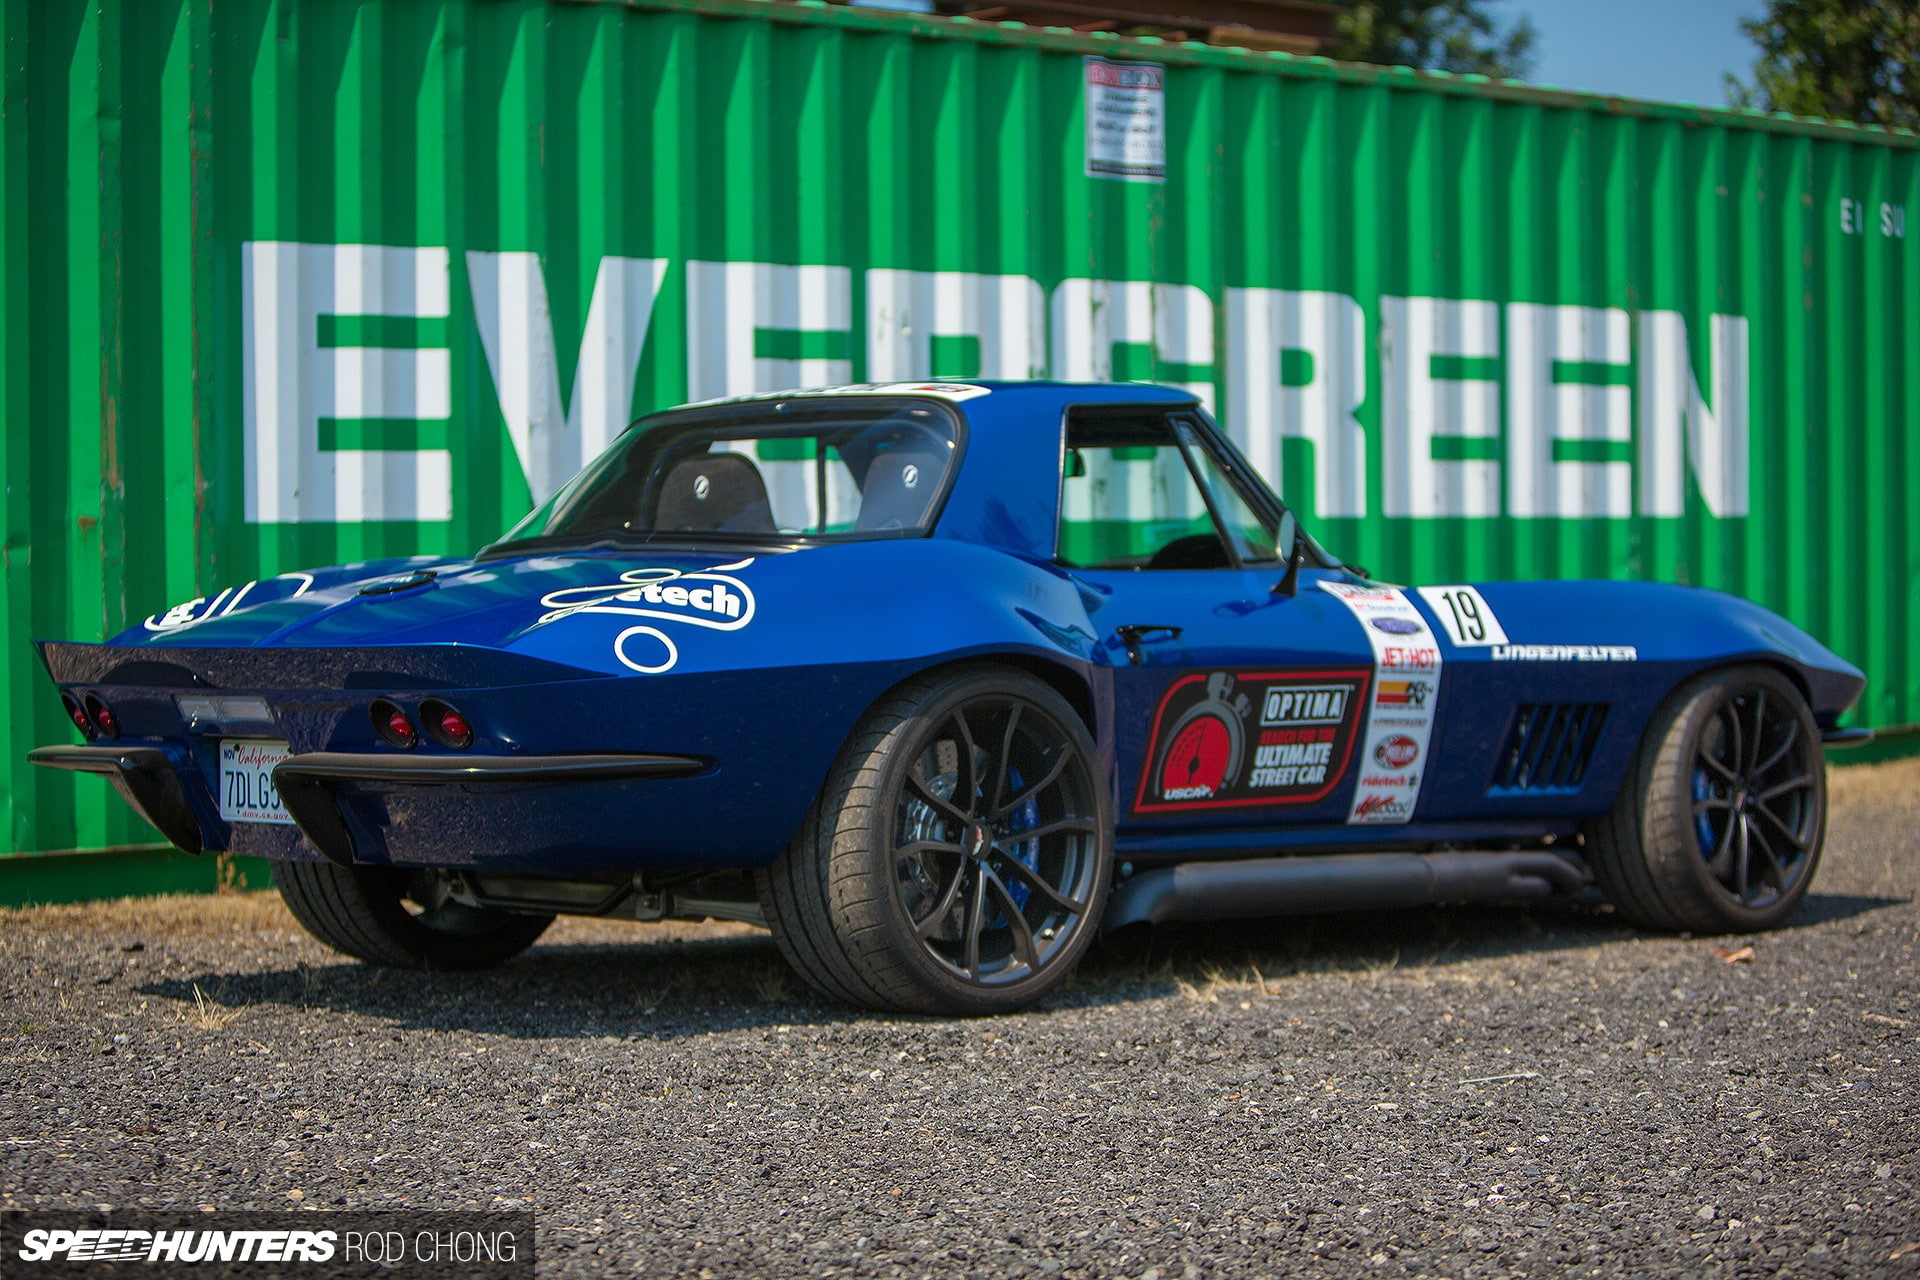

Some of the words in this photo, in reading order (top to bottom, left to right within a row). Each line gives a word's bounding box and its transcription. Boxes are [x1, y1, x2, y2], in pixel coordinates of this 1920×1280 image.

[1442, 591, 1486, 642] 19
[1492, 645, 1638, 661] LINGENFELTER
[1267, 692, 1342, 720] OPTIMA
[223, 749, 235, 761] NOV
[238, 746, 289, 771] California
[1255, 742, 1334, 768] ULTIMATE
[1249, 766, 1298, 788] STREET
[1297, 765, 1327, 785] CAR
